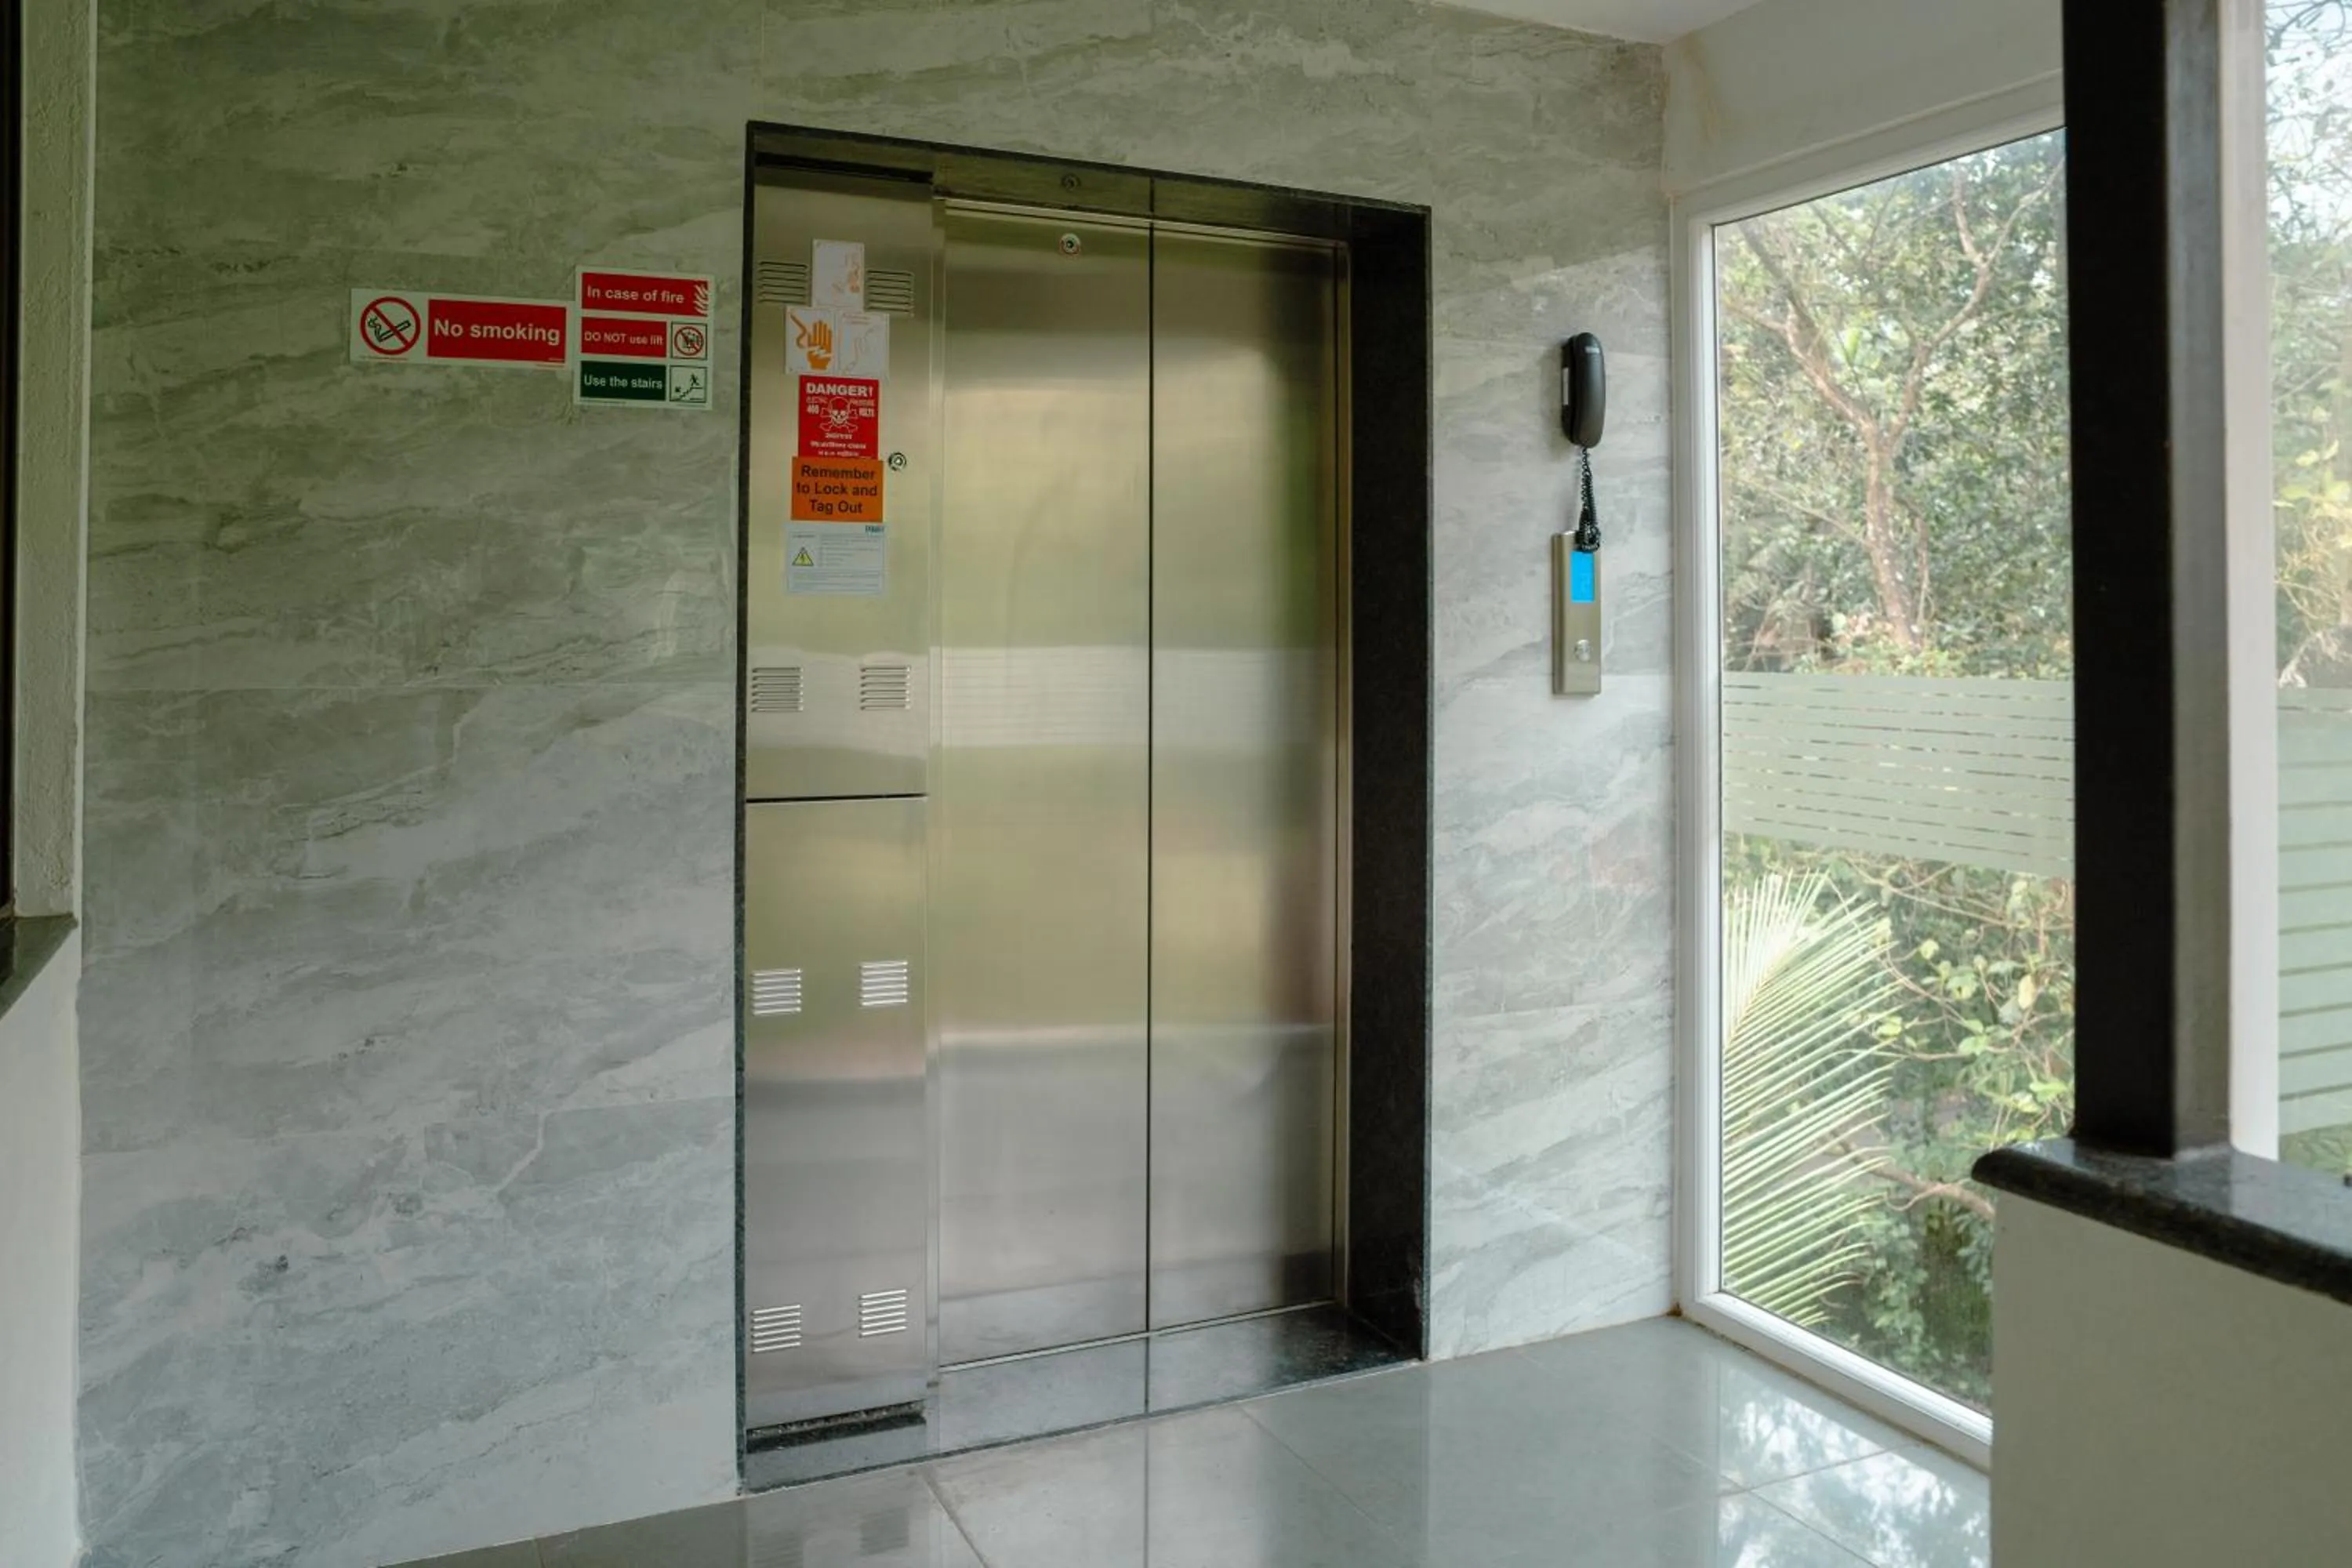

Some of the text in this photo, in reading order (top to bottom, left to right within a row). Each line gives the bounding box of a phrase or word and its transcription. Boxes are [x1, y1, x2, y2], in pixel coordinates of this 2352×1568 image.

[586, 285, 684, 304] In case of fire
[434, 319, 561, 345] No smoking
[584, 331, 663, 346] DO NOT use lift
[584, 374, 662, 390] Use the stairs
[800, 465, 874, 480] Remember
[797, 482, 877, 495] to Lock and
[809, 499, 862, 514] Tag Out
